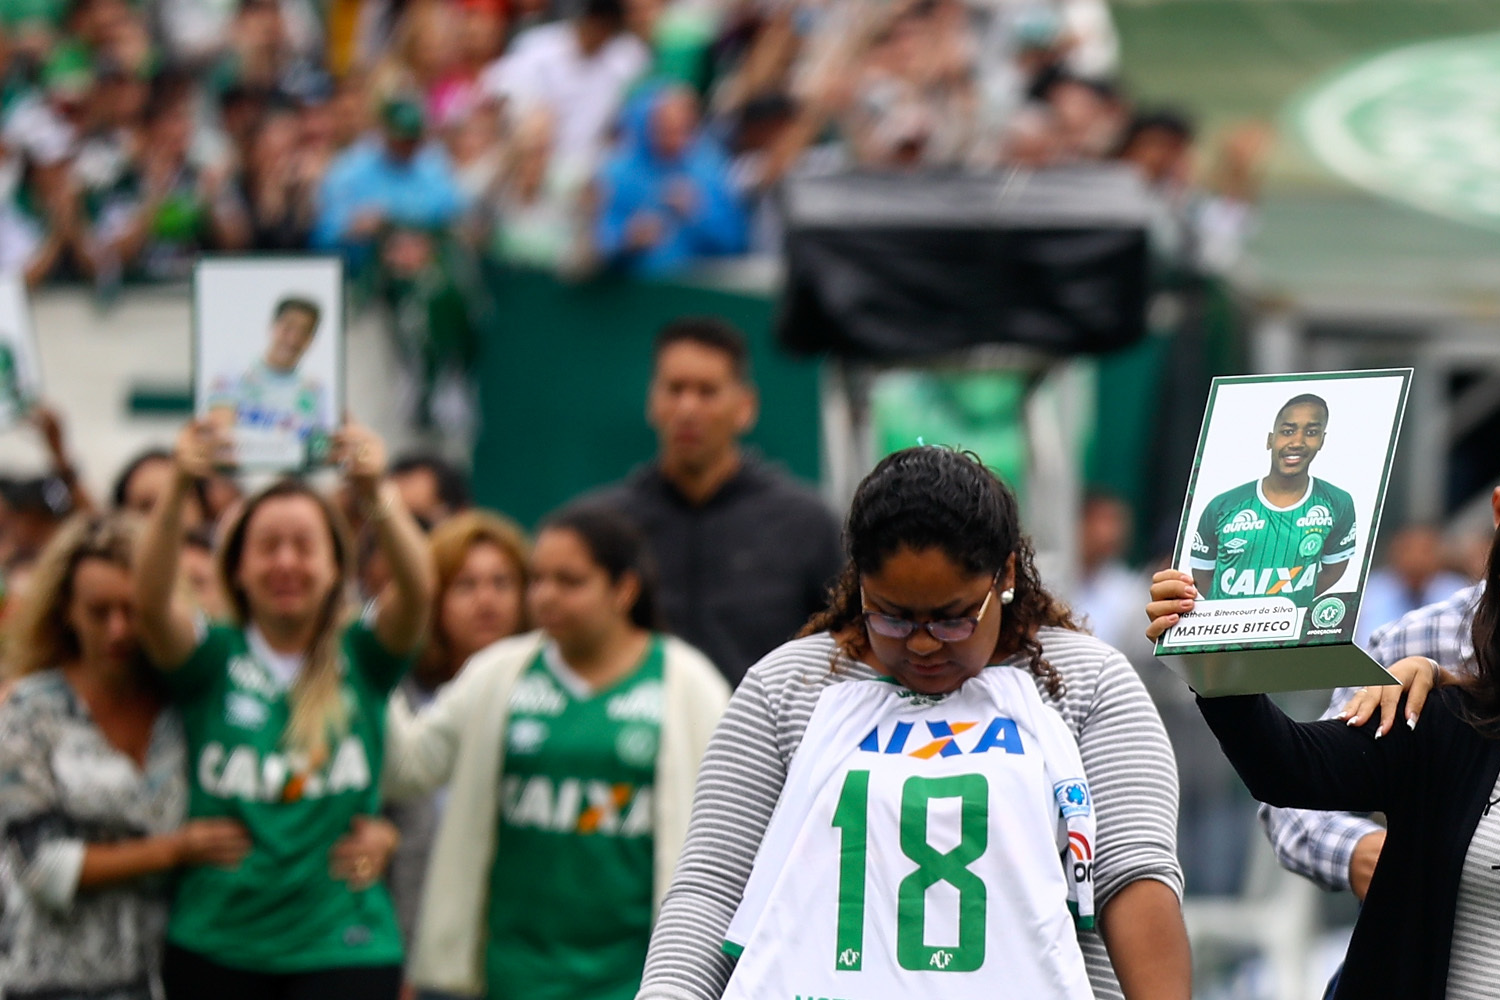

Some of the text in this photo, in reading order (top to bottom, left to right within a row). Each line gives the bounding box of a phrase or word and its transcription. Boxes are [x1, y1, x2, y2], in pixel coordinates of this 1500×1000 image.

[1222, 519, 1266, 534] aurora
[1191, 542, 1210, 554] ora
[1220, 562, 1317, 595] CAIXA
[1214, 608, 1257, 617] Bitencourt
[1258, 606, 1270, 615] da
[1272, 605, 1294, 614] Silva
[1174, 620, 1291, 637] MATHEUS BITECO
[858, 716, 1026, 761] IXA
[832, 769, 989, 973] 18
